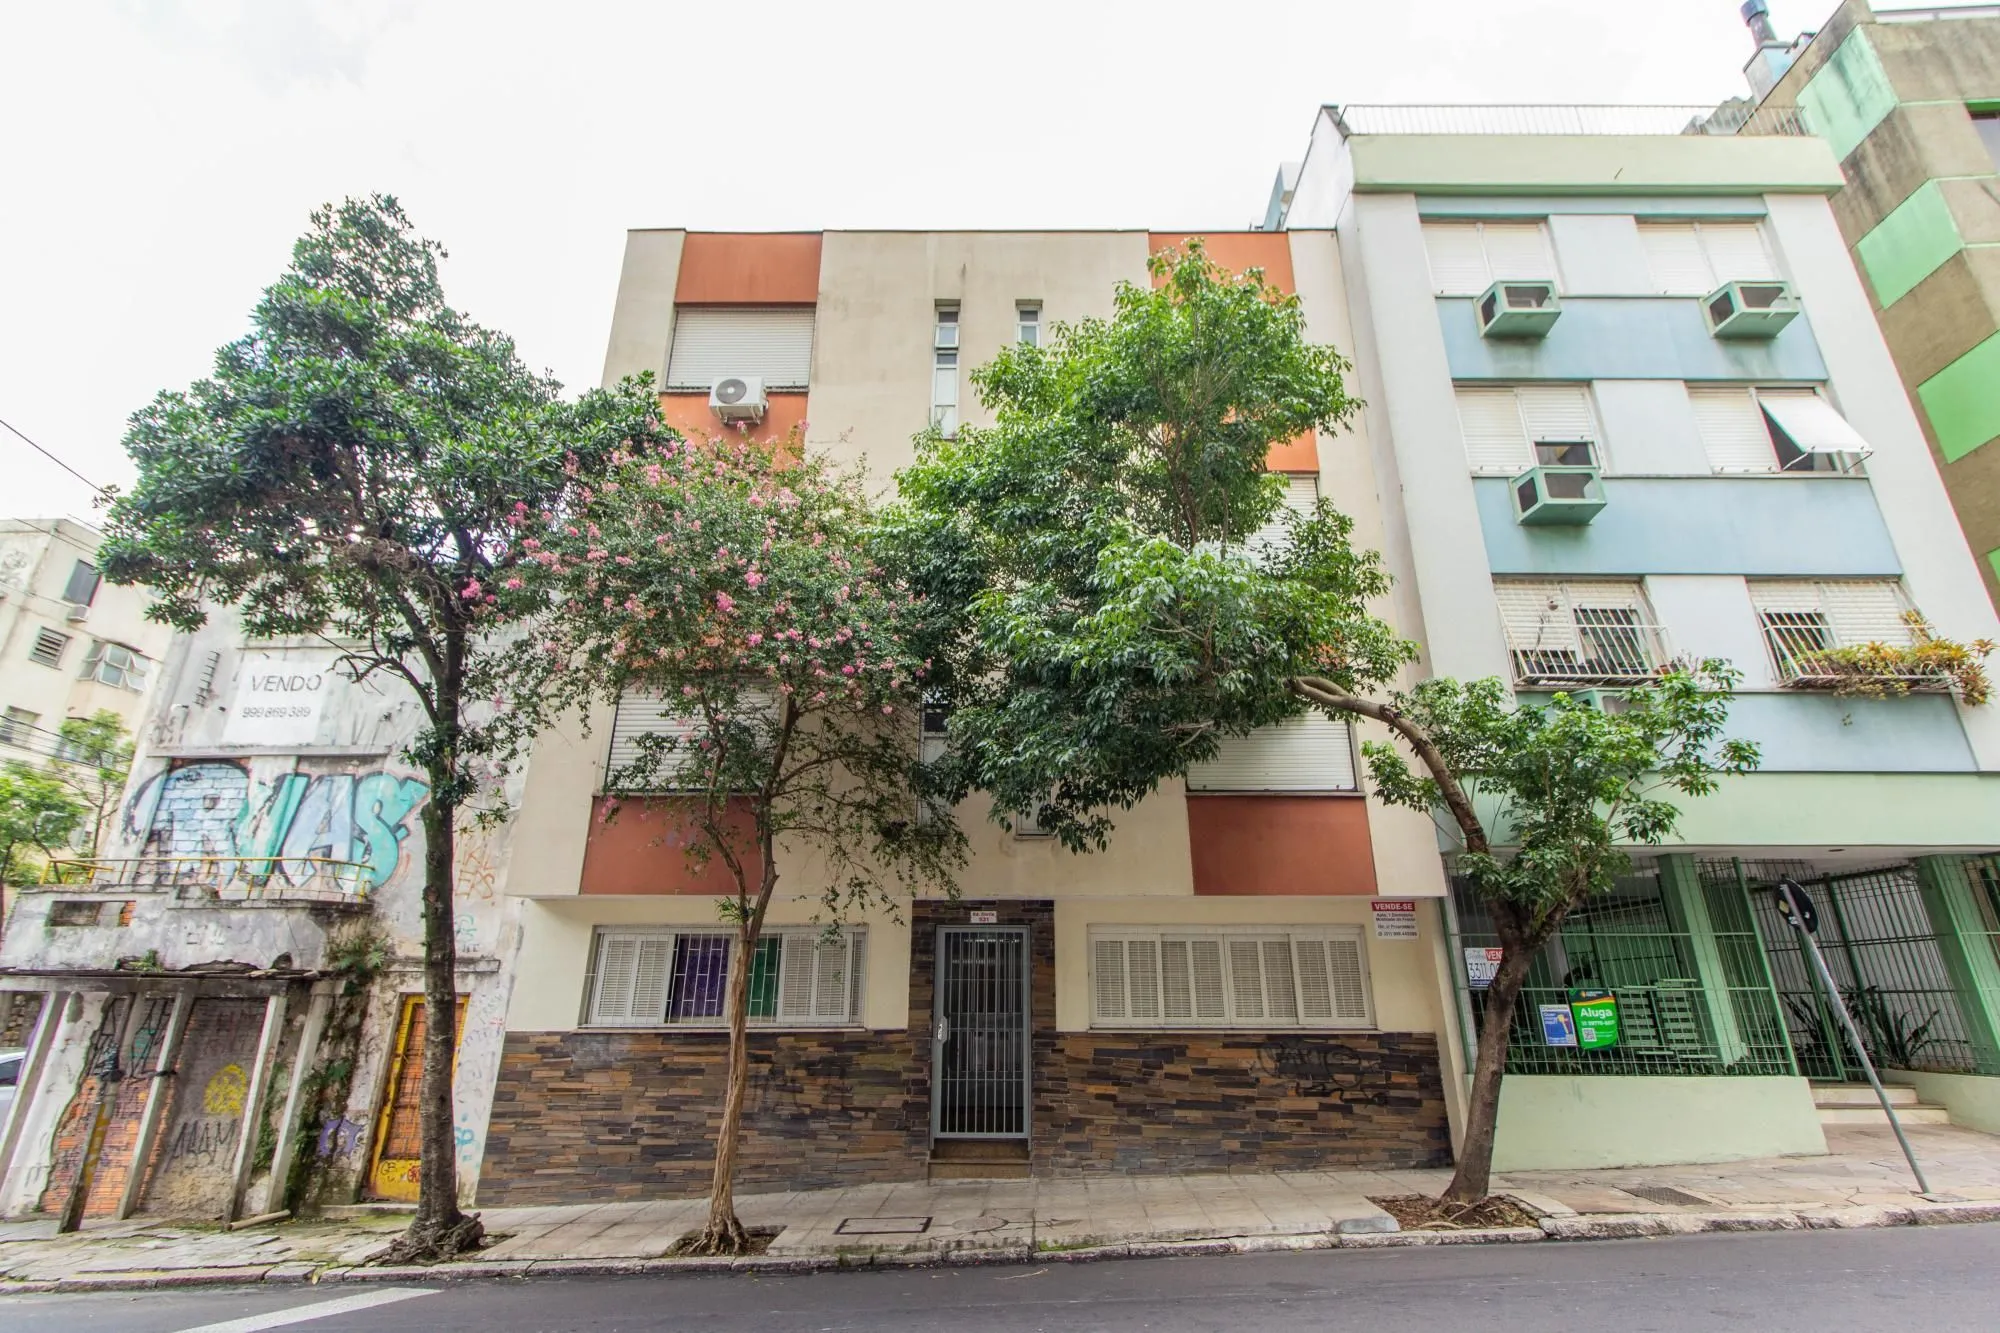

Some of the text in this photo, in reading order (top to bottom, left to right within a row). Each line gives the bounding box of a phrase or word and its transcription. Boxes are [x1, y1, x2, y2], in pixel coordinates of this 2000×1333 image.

[252, 674, 322, 692] VENDO
[1486, 951, 1503, 960] VEN
[1580, 1007, 1613, 1019] Aluga
